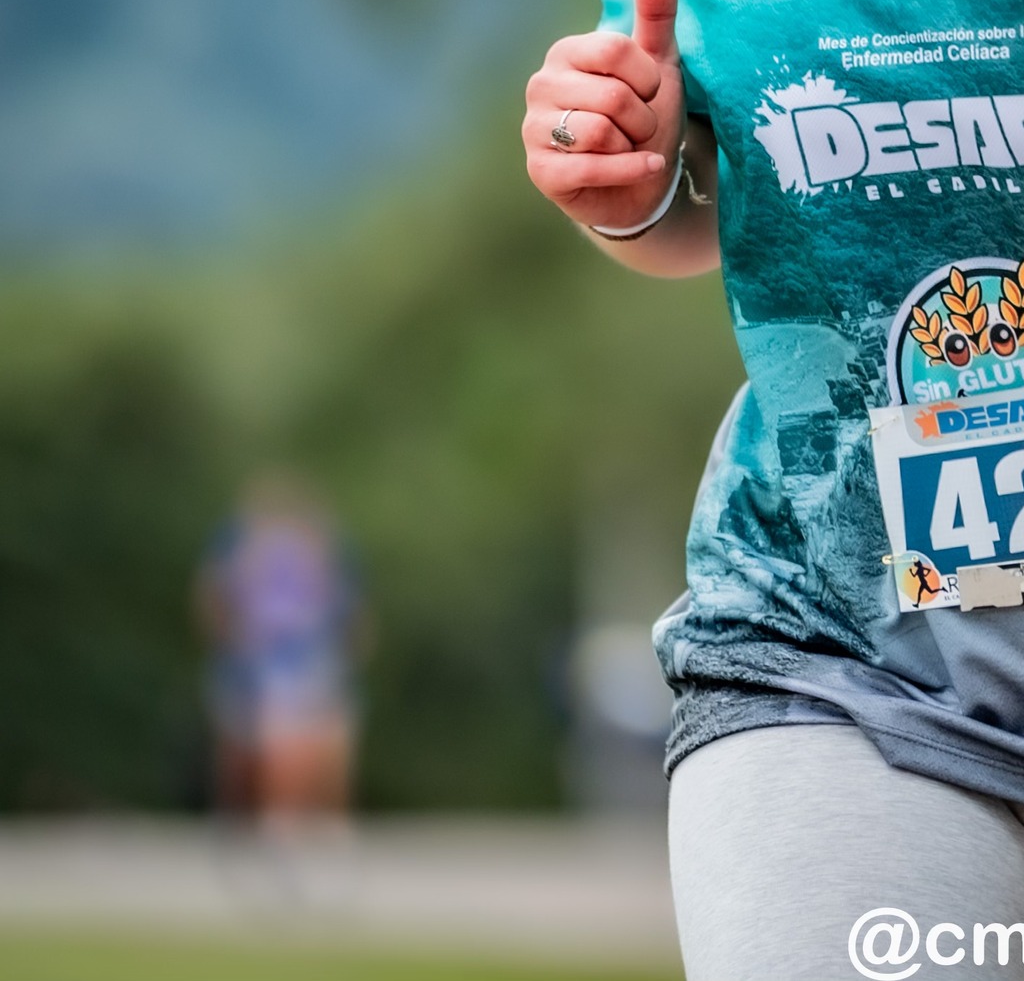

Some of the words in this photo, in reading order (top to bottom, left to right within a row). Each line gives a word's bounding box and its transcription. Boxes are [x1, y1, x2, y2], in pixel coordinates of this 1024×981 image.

[818, 36, 847, 50] Mes
[851, 34, 869, 48] de
[872, 27, 975, 47] Concientización
[977, 25, 1017, 41] sobre
[841, 46, 944, 68] Enfermedad
[947, 43, 1011, 61] Celíaca
[864, 182, 905, 201] EL
[912, 378, 951, 405] Sin
